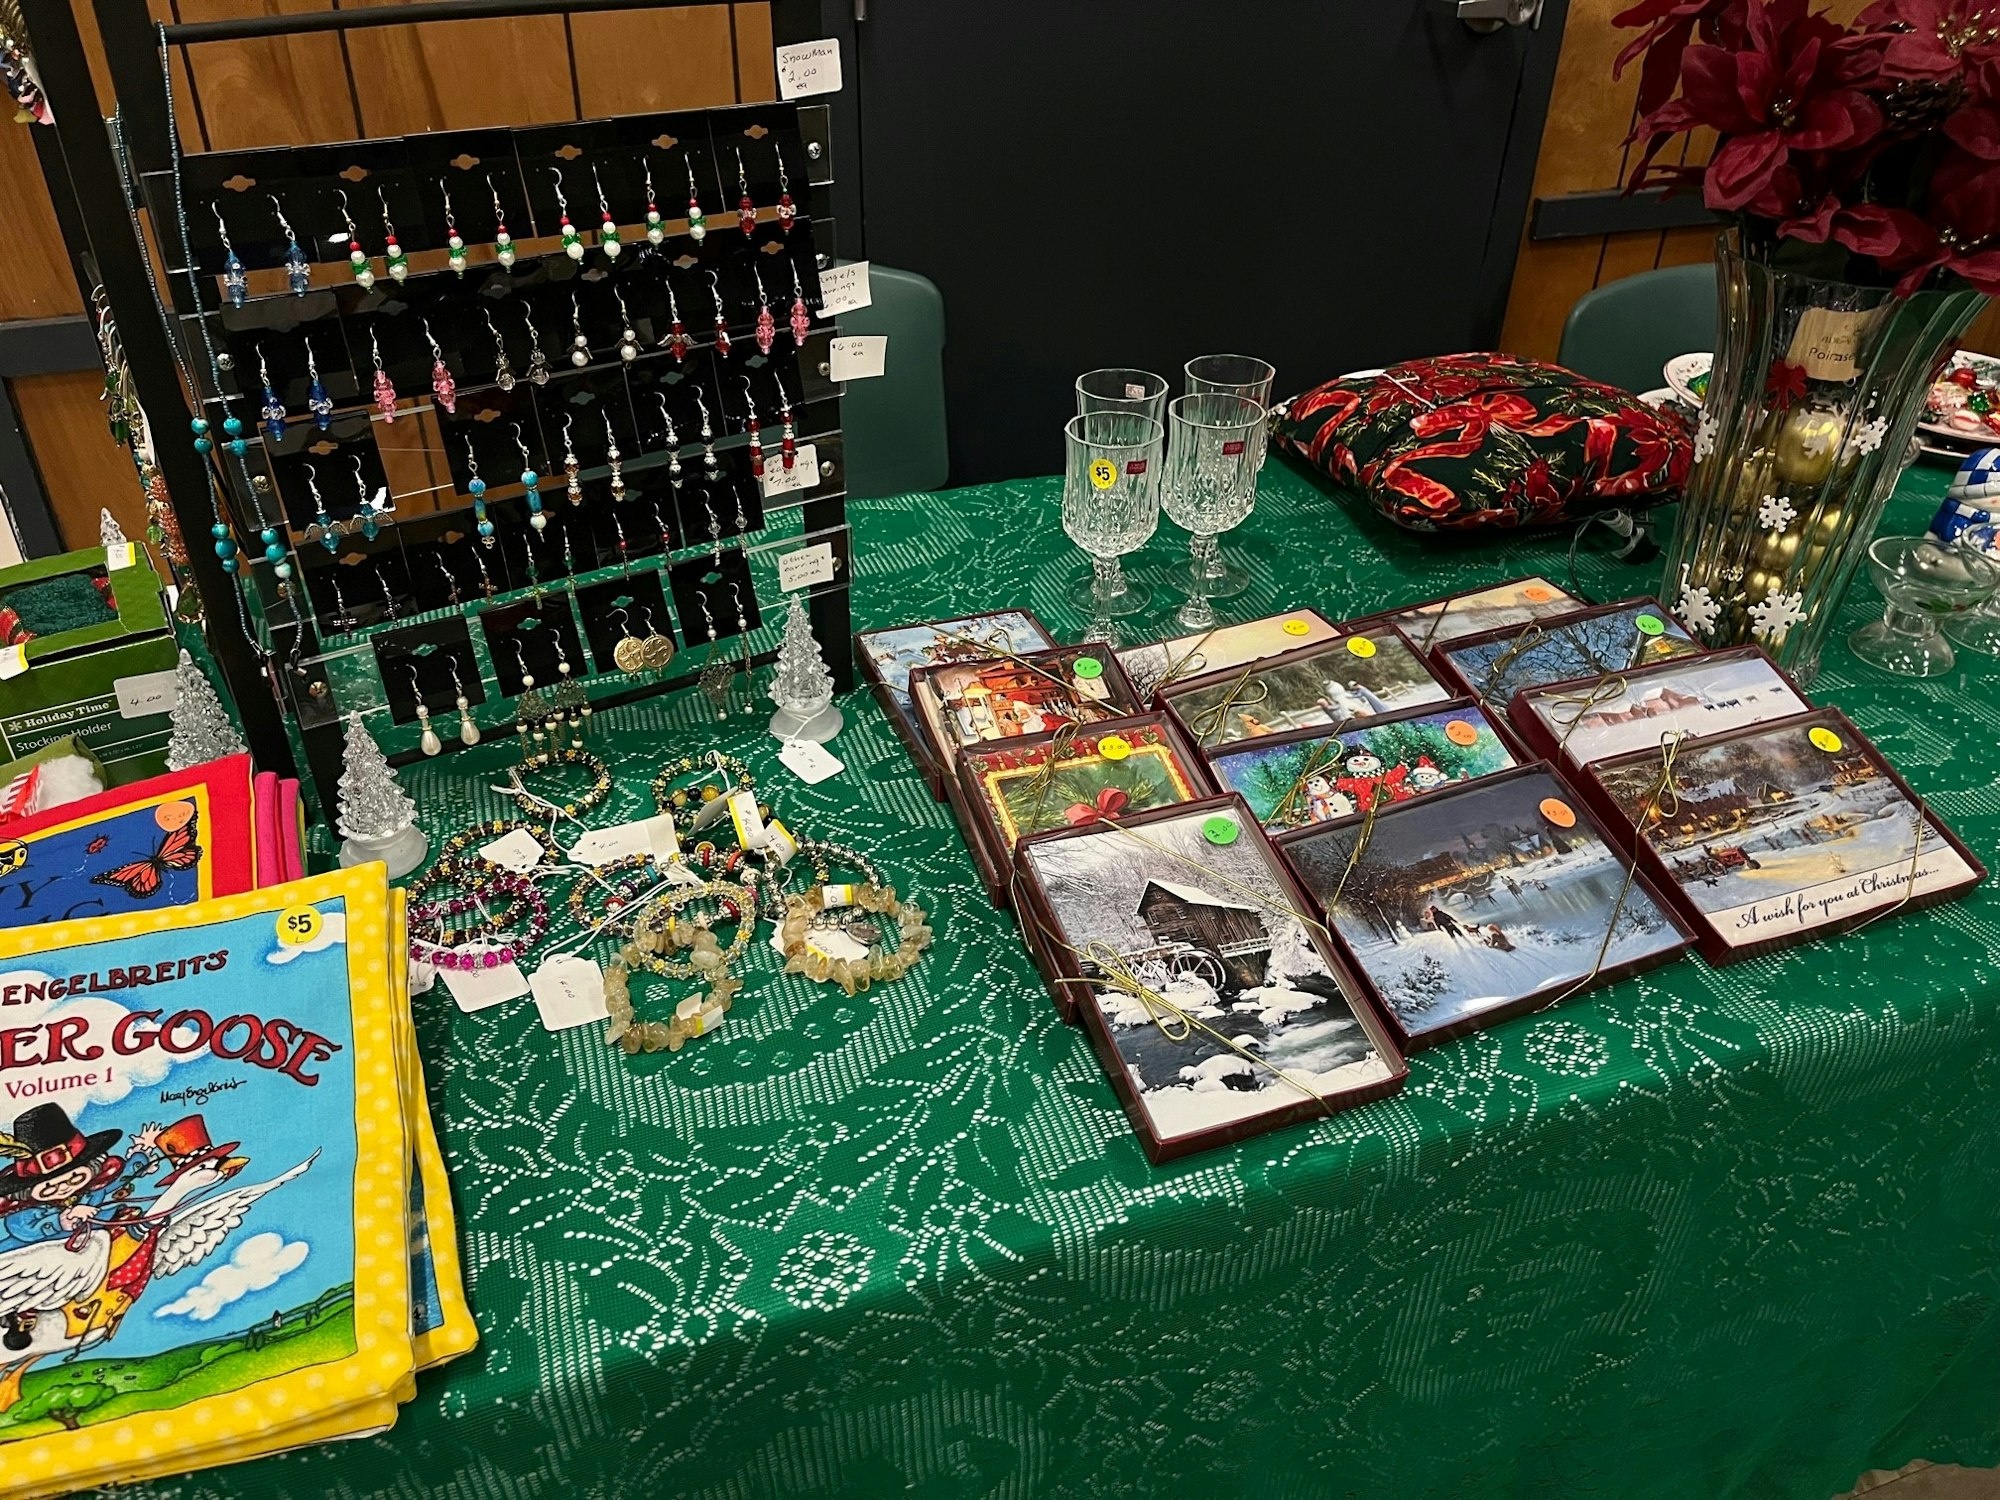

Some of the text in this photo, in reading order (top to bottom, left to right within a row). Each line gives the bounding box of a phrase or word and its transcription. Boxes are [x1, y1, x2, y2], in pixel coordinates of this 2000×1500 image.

[1095, 466, 1110, 482] $5
[24, 709, 76, 729] Holiday
[16, 721, 112, 752] Stockin Holder
[1736, 906, 1760, 928] A
[1763, 897, 1795, 922] wish
[1797, 893, 1816, 924] for
[1818, 895, 1844, 917] you
[1846, 886, 1860, 899] at
[287, 913, 312, 934] $5
[111, 1008, 343, 1087] GOOSE
[5, 1066, 114, 1099] Volume 1
